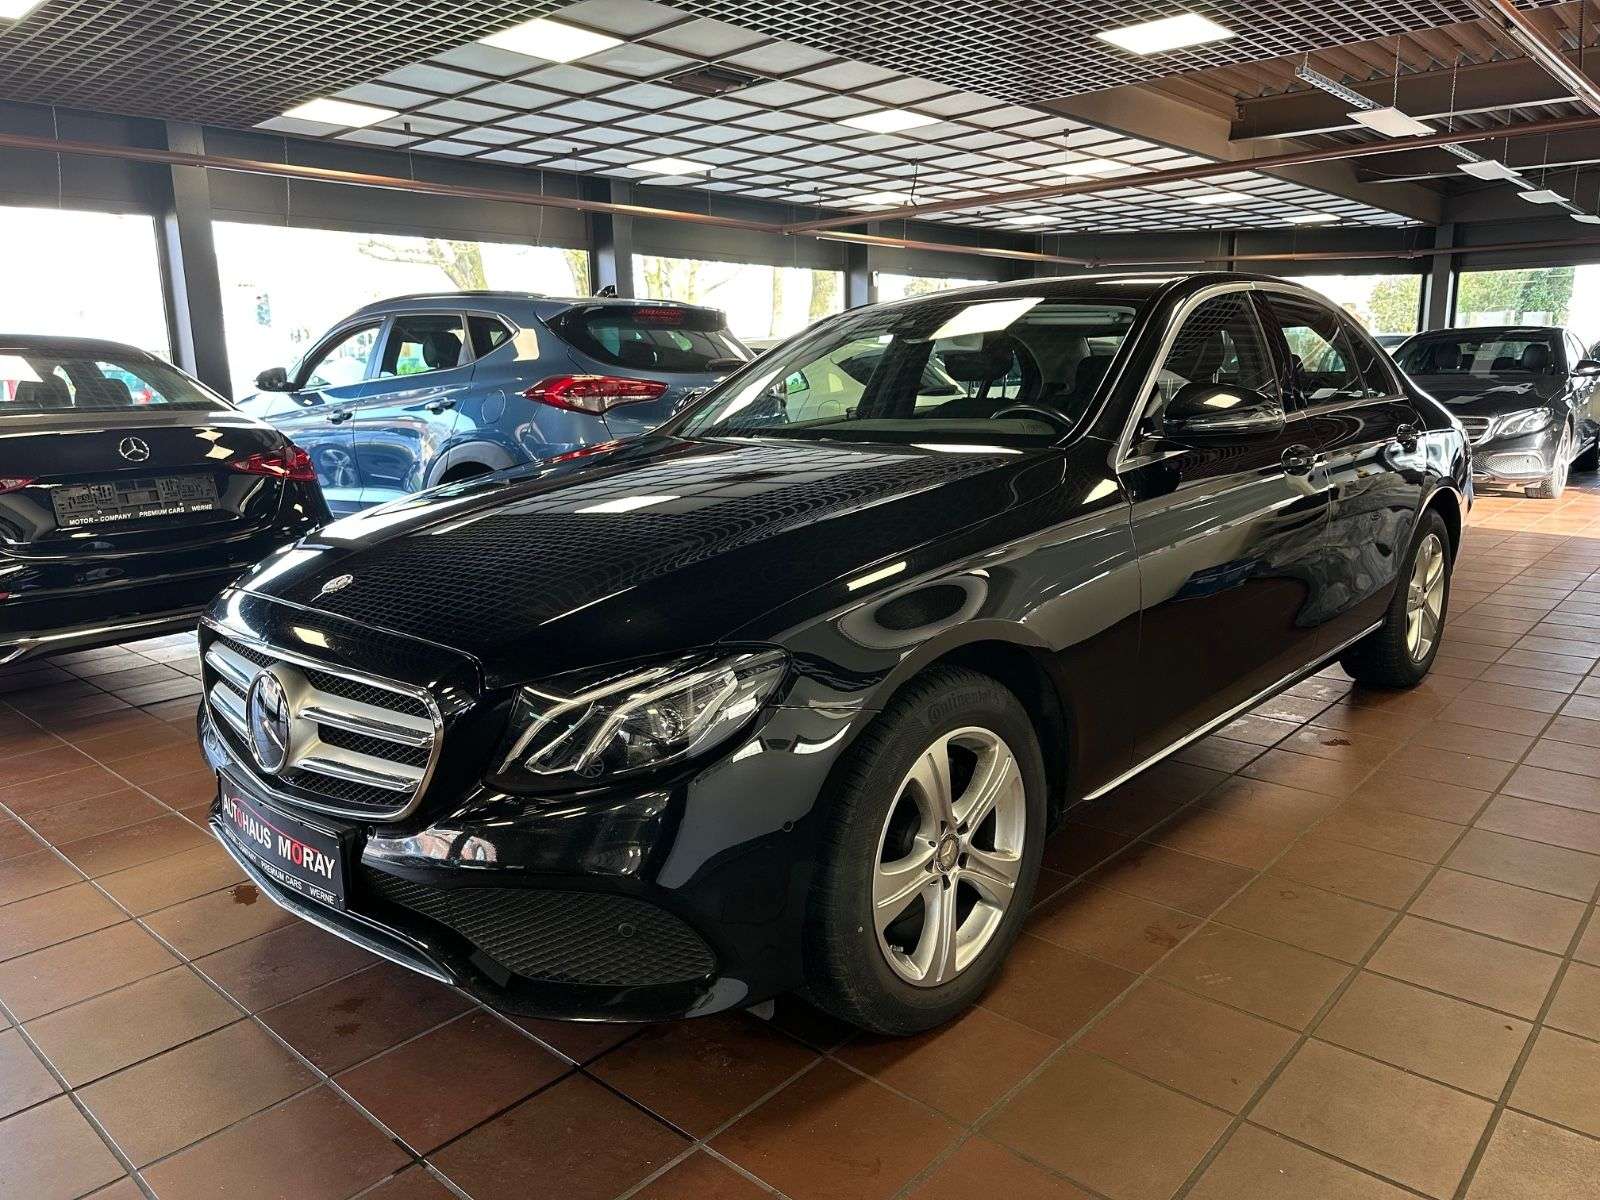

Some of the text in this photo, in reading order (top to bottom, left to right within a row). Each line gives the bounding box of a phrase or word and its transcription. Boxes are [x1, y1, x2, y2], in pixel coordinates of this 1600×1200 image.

[69, 517, 94, 526] MOTOR
[100, 512, 132, 522] COMPANY
[139, 507, 167, 518] PREMIUM
[169, 506, 185, 515] CARS
[223, 793, 272, 849] AUTOHAUS
[278, 835, 336, 879] MORAY
[285, 874, 303, 891] CARS
[310, 886, 335, 905] WERNE
